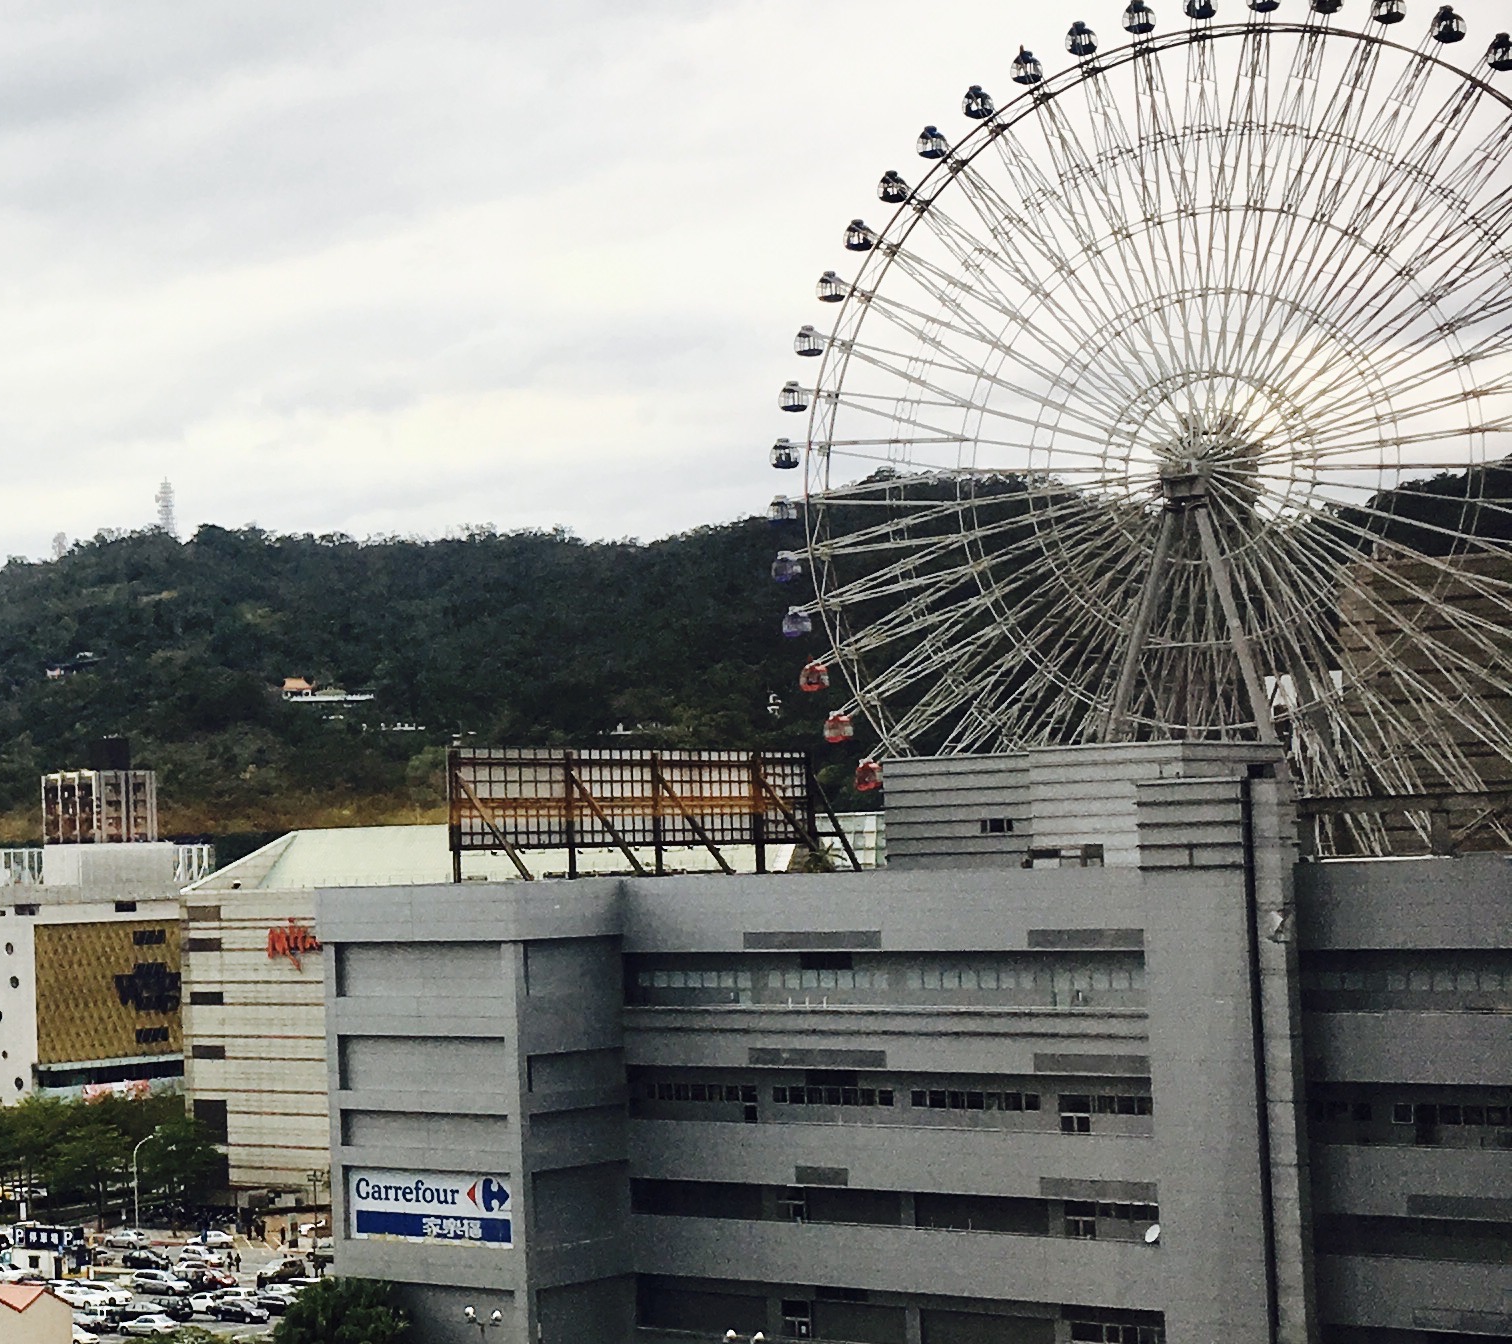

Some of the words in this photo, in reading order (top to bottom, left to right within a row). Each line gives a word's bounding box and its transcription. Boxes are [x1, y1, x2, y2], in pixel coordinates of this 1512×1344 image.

[355, 1177, 459, 1205] Carrefour
[422, 1216, 482, 1239] 家樂福
